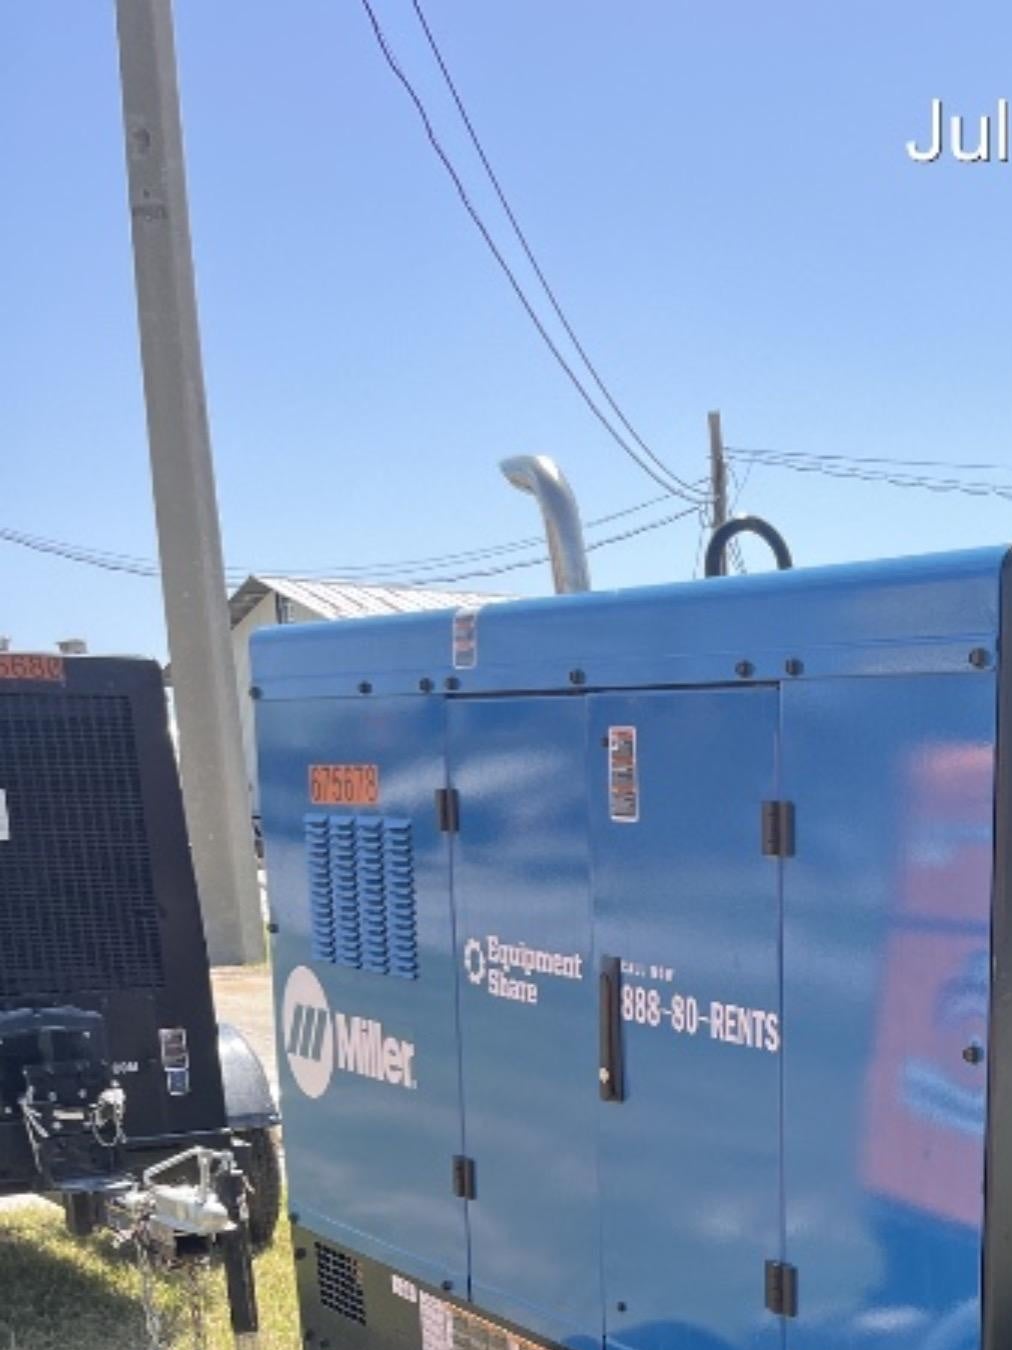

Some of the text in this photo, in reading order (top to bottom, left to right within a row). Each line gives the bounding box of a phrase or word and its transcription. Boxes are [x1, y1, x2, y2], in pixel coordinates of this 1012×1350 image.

[310, 765, 378, 803] 675678
[486, 935, 583, 980] Equipment
[487, 969, 538, 1004] Share
[335, 1012, 417, 1090] Miller
